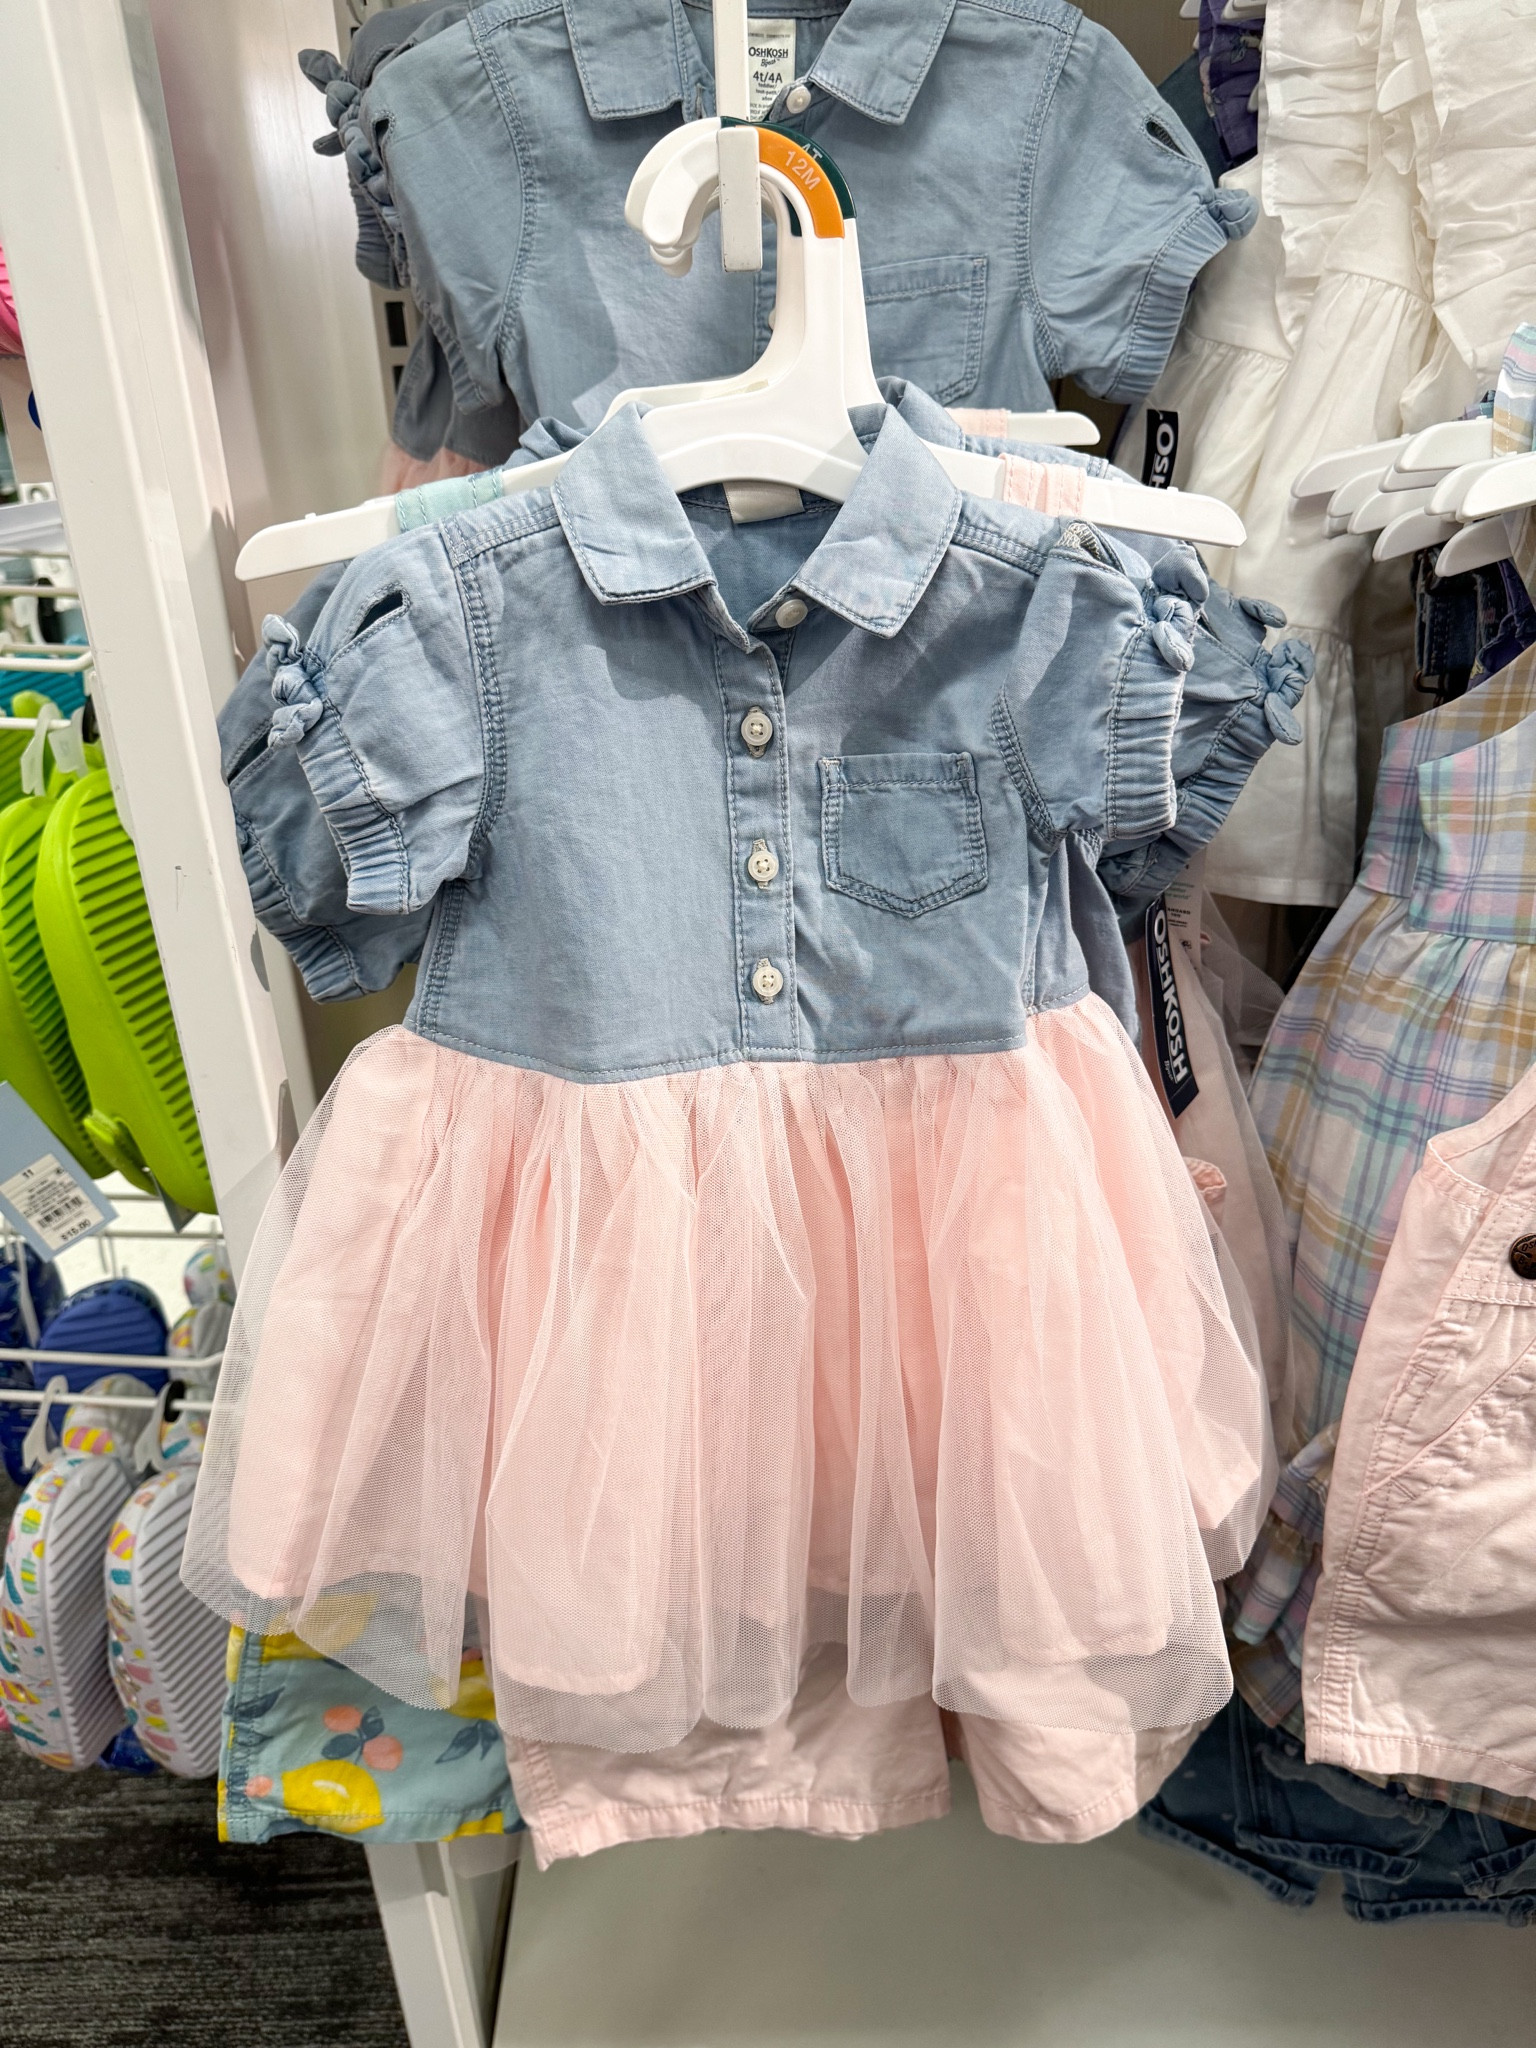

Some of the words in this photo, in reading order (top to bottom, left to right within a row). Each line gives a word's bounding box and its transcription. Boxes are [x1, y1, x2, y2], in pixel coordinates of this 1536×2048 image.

[748, 46, 789, 58] OSHKOSH
[753, 71, 783, 84] 4t/4A
[785, 151, 821, 191] 12M
[1154, 909, 1188, 1083] OSHKOSH
